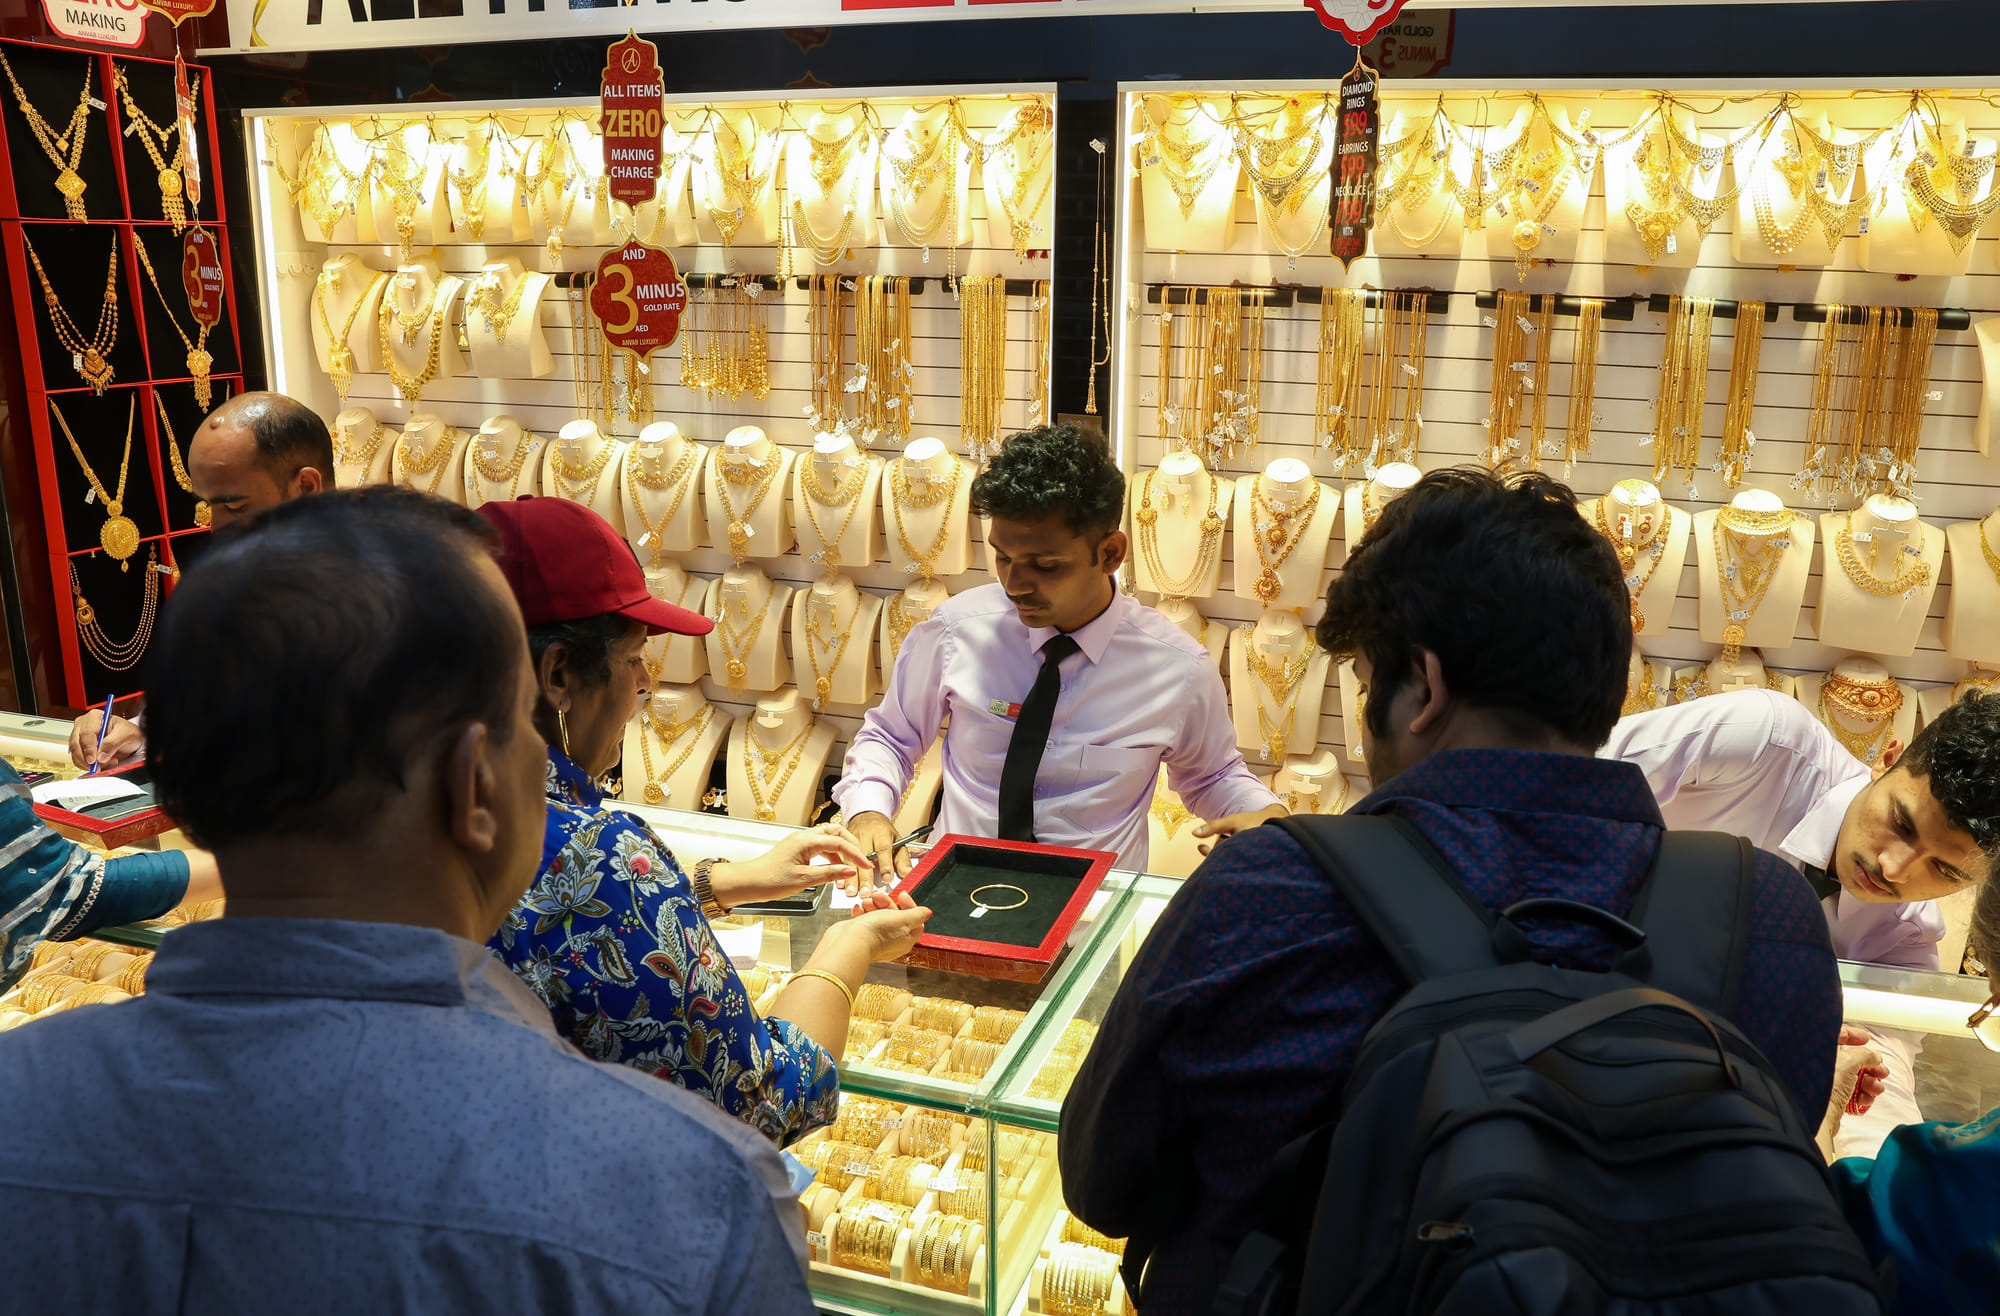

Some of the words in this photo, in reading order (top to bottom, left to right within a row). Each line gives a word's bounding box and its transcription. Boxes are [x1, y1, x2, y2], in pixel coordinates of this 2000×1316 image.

[173, 2, 193, 10] LUXURY
[66, 8, 125, 31] MAKING
[604, 85, 624, 97] ALL
[627, 84, 661, 97] ITEMS
[1342, 81, 1373, 97] DIAMOND
[1346, 96, 1365, 109] RINGS
[605, 109, 660, 137] ZERO
[1342, 110, 1367, 138] 599
[1338, 141, 1368, 155] EARRINGS
[611, 149, 655, 161] MAKING
[611, 166, 654, 179] CHARGE
[1340, 155, 1365, 180] 599
[1335, 184, 1366, 197] NECKLACE
[1337, 199, 1362, 224] 799
[193, 233, 204, 243] AND
[622, 248, 646, 261] AND
[186, 245, 203, 308] 3
[200, 266, 221, 280] MINUS
[603, 263, 639, 334] 3
[636, 283, 684, 299] MINUS
[643, 303, 662, 312] GOLD
[663, 303, 680, 311] RATE
